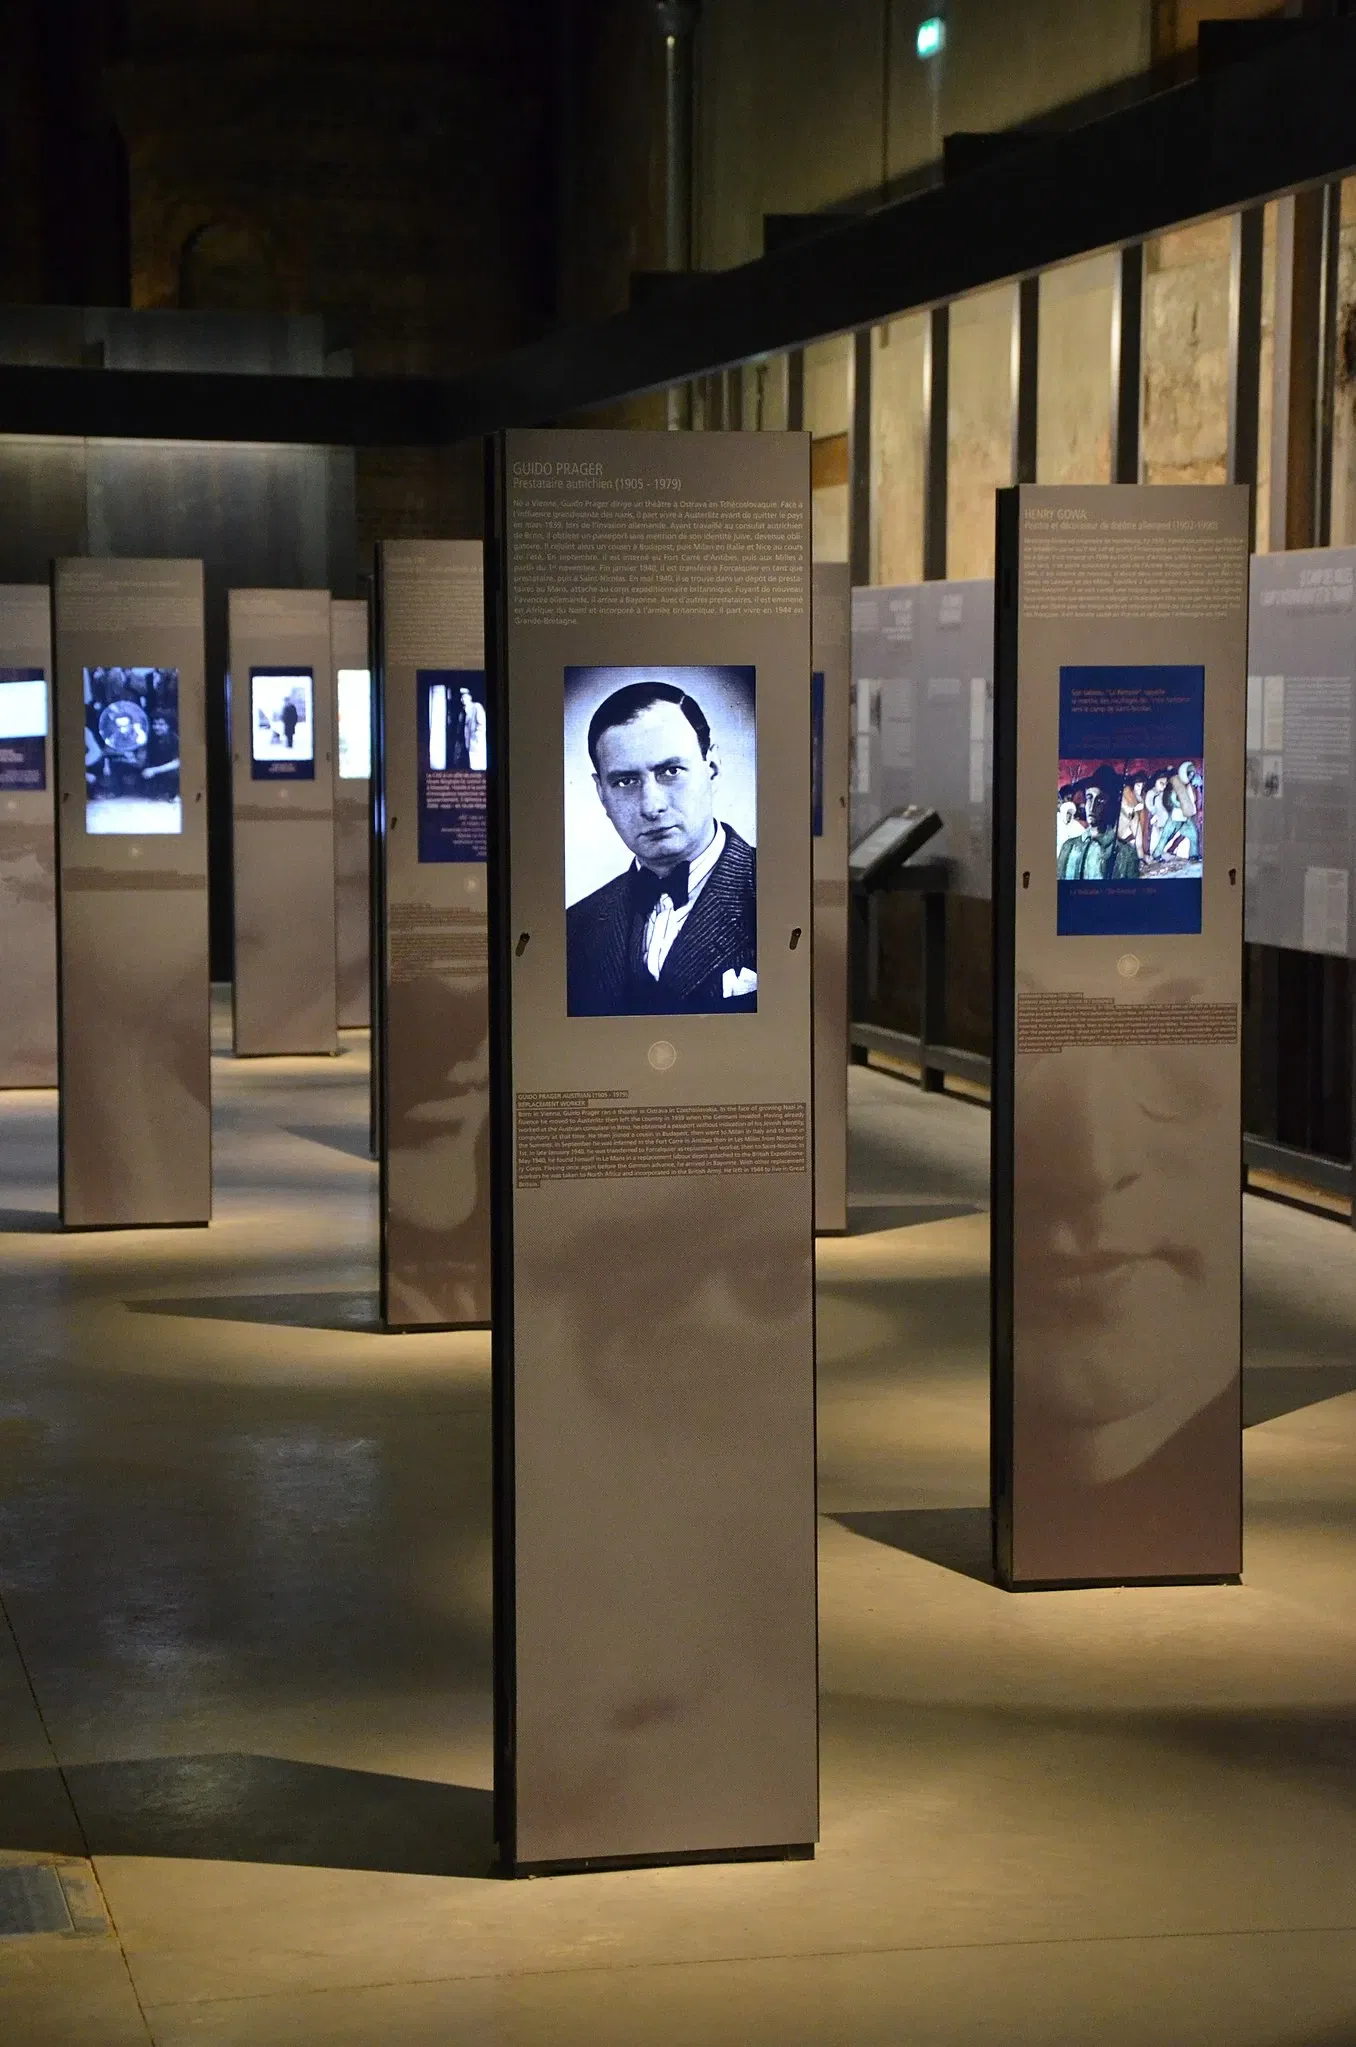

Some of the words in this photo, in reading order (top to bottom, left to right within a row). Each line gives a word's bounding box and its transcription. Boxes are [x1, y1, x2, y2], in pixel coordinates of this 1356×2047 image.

[512, 462, 552, 476] GUIDO
[556, 462, 603, 476] PRAGER
[512, 478, 564, 489] Prestataire
[566, 478, 613, 489] autrichien
[615, 478, 644, 492] (1905
[654, 478, 682, 492] 1979)
